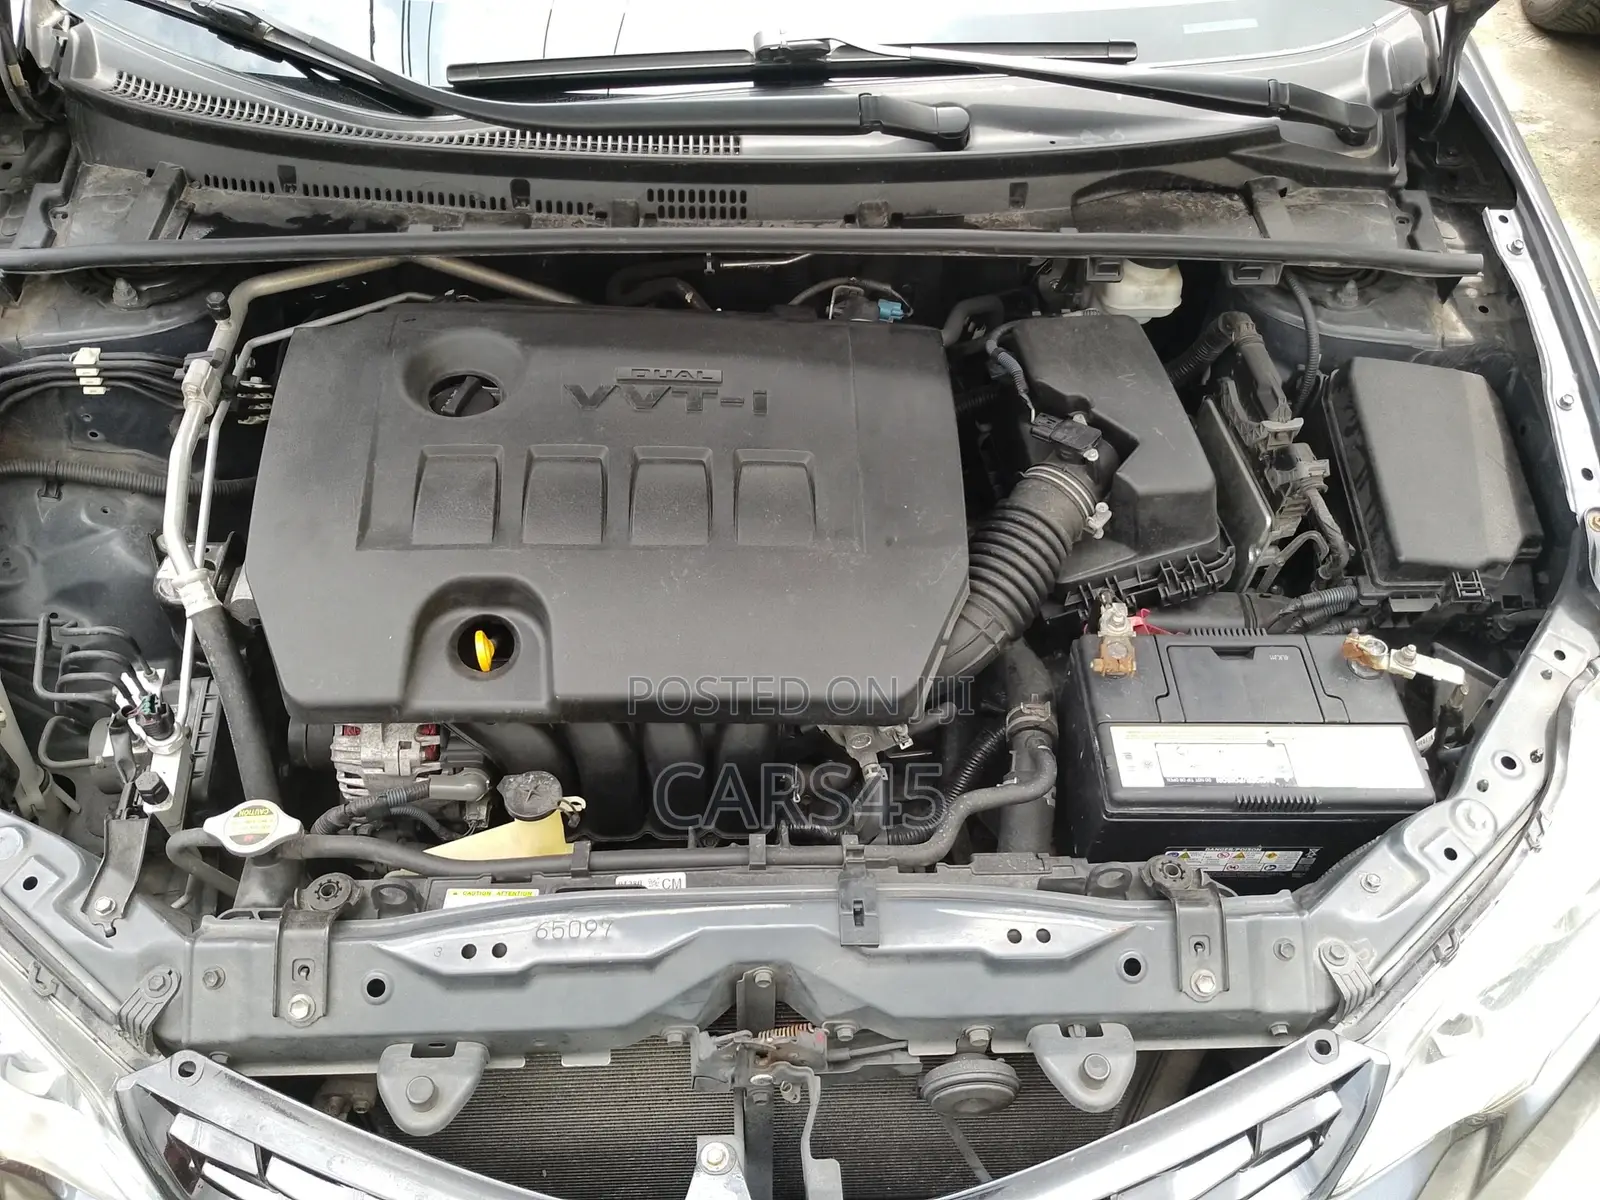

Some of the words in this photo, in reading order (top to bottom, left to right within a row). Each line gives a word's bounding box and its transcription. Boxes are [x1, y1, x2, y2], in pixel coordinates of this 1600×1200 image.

[631, 368, 714, 379] DUAL
[238, 808, 269, 817] CAUTION
[662, 878, 682, 890] CM
[535, 919, 615, 940] 65097
